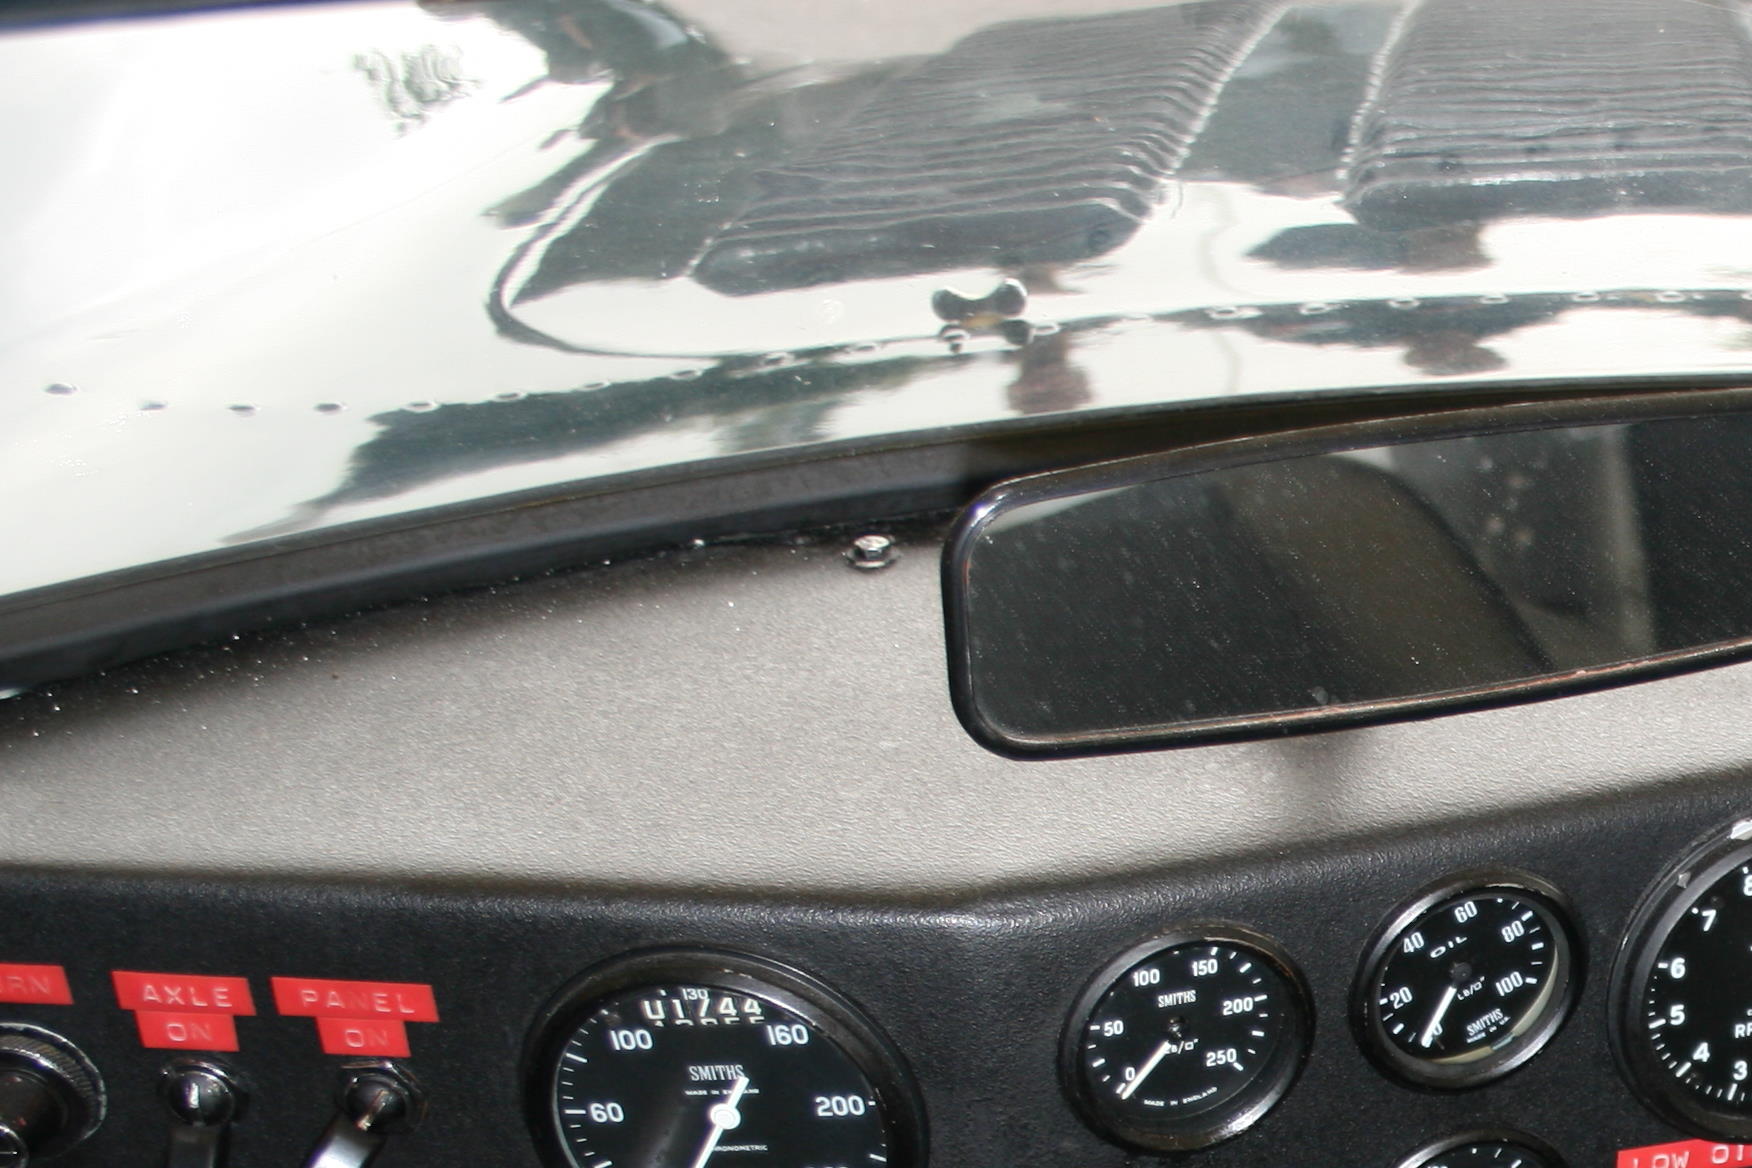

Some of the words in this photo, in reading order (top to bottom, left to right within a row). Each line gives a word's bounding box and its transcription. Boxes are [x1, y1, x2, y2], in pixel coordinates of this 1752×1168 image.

[1455, 901, 1478, 923] 60
[1702, 909, 1718, 932] 7
[1403, 932, 1424, 953] 40
[1501, 921, 1525, 943] 80
[1430, 936, 1467, 958] OIL
[1133, 969, 1160, 987] 100
[1193, 960, 1218, 977] 150
[1670, 958, 1685, 979] 6
[682, 988, 708, 1000] 130
[1495, 971, 1523, 996] 100
[143, 984, 232, 1007] AXLE
[302, 990, 415, 1014] PANEL
[1158, 990, 1196, 1008] SMITHS
[1223, 997, 1253, 1015] 200
[1390, 986, 1413, 1009] 20
[1466, 1008, 1503, 1036] SMITHS
[1669, 1004, 1685, 1025] 5
[166, 1023, 213, 1043] ON
[345, 1029, 389, 1047] ON
[767, 1024, 809, 1047] 160
[1104, 1020, 1124, 1037] 50
[610, 1029, 653, 1051] 100
[1206, 1048, 1237, 1066] 250
[1693, 1042, 1710, 1063] 4
[689, 1064, 745, 1081] SMITHS
[1125, 1067, 1135, 1081] 0
[1733, 1060, 1748, 1081] 3
[590, 1102, 624, 1123] 60
[815, 1095, 865, 1118] 200
